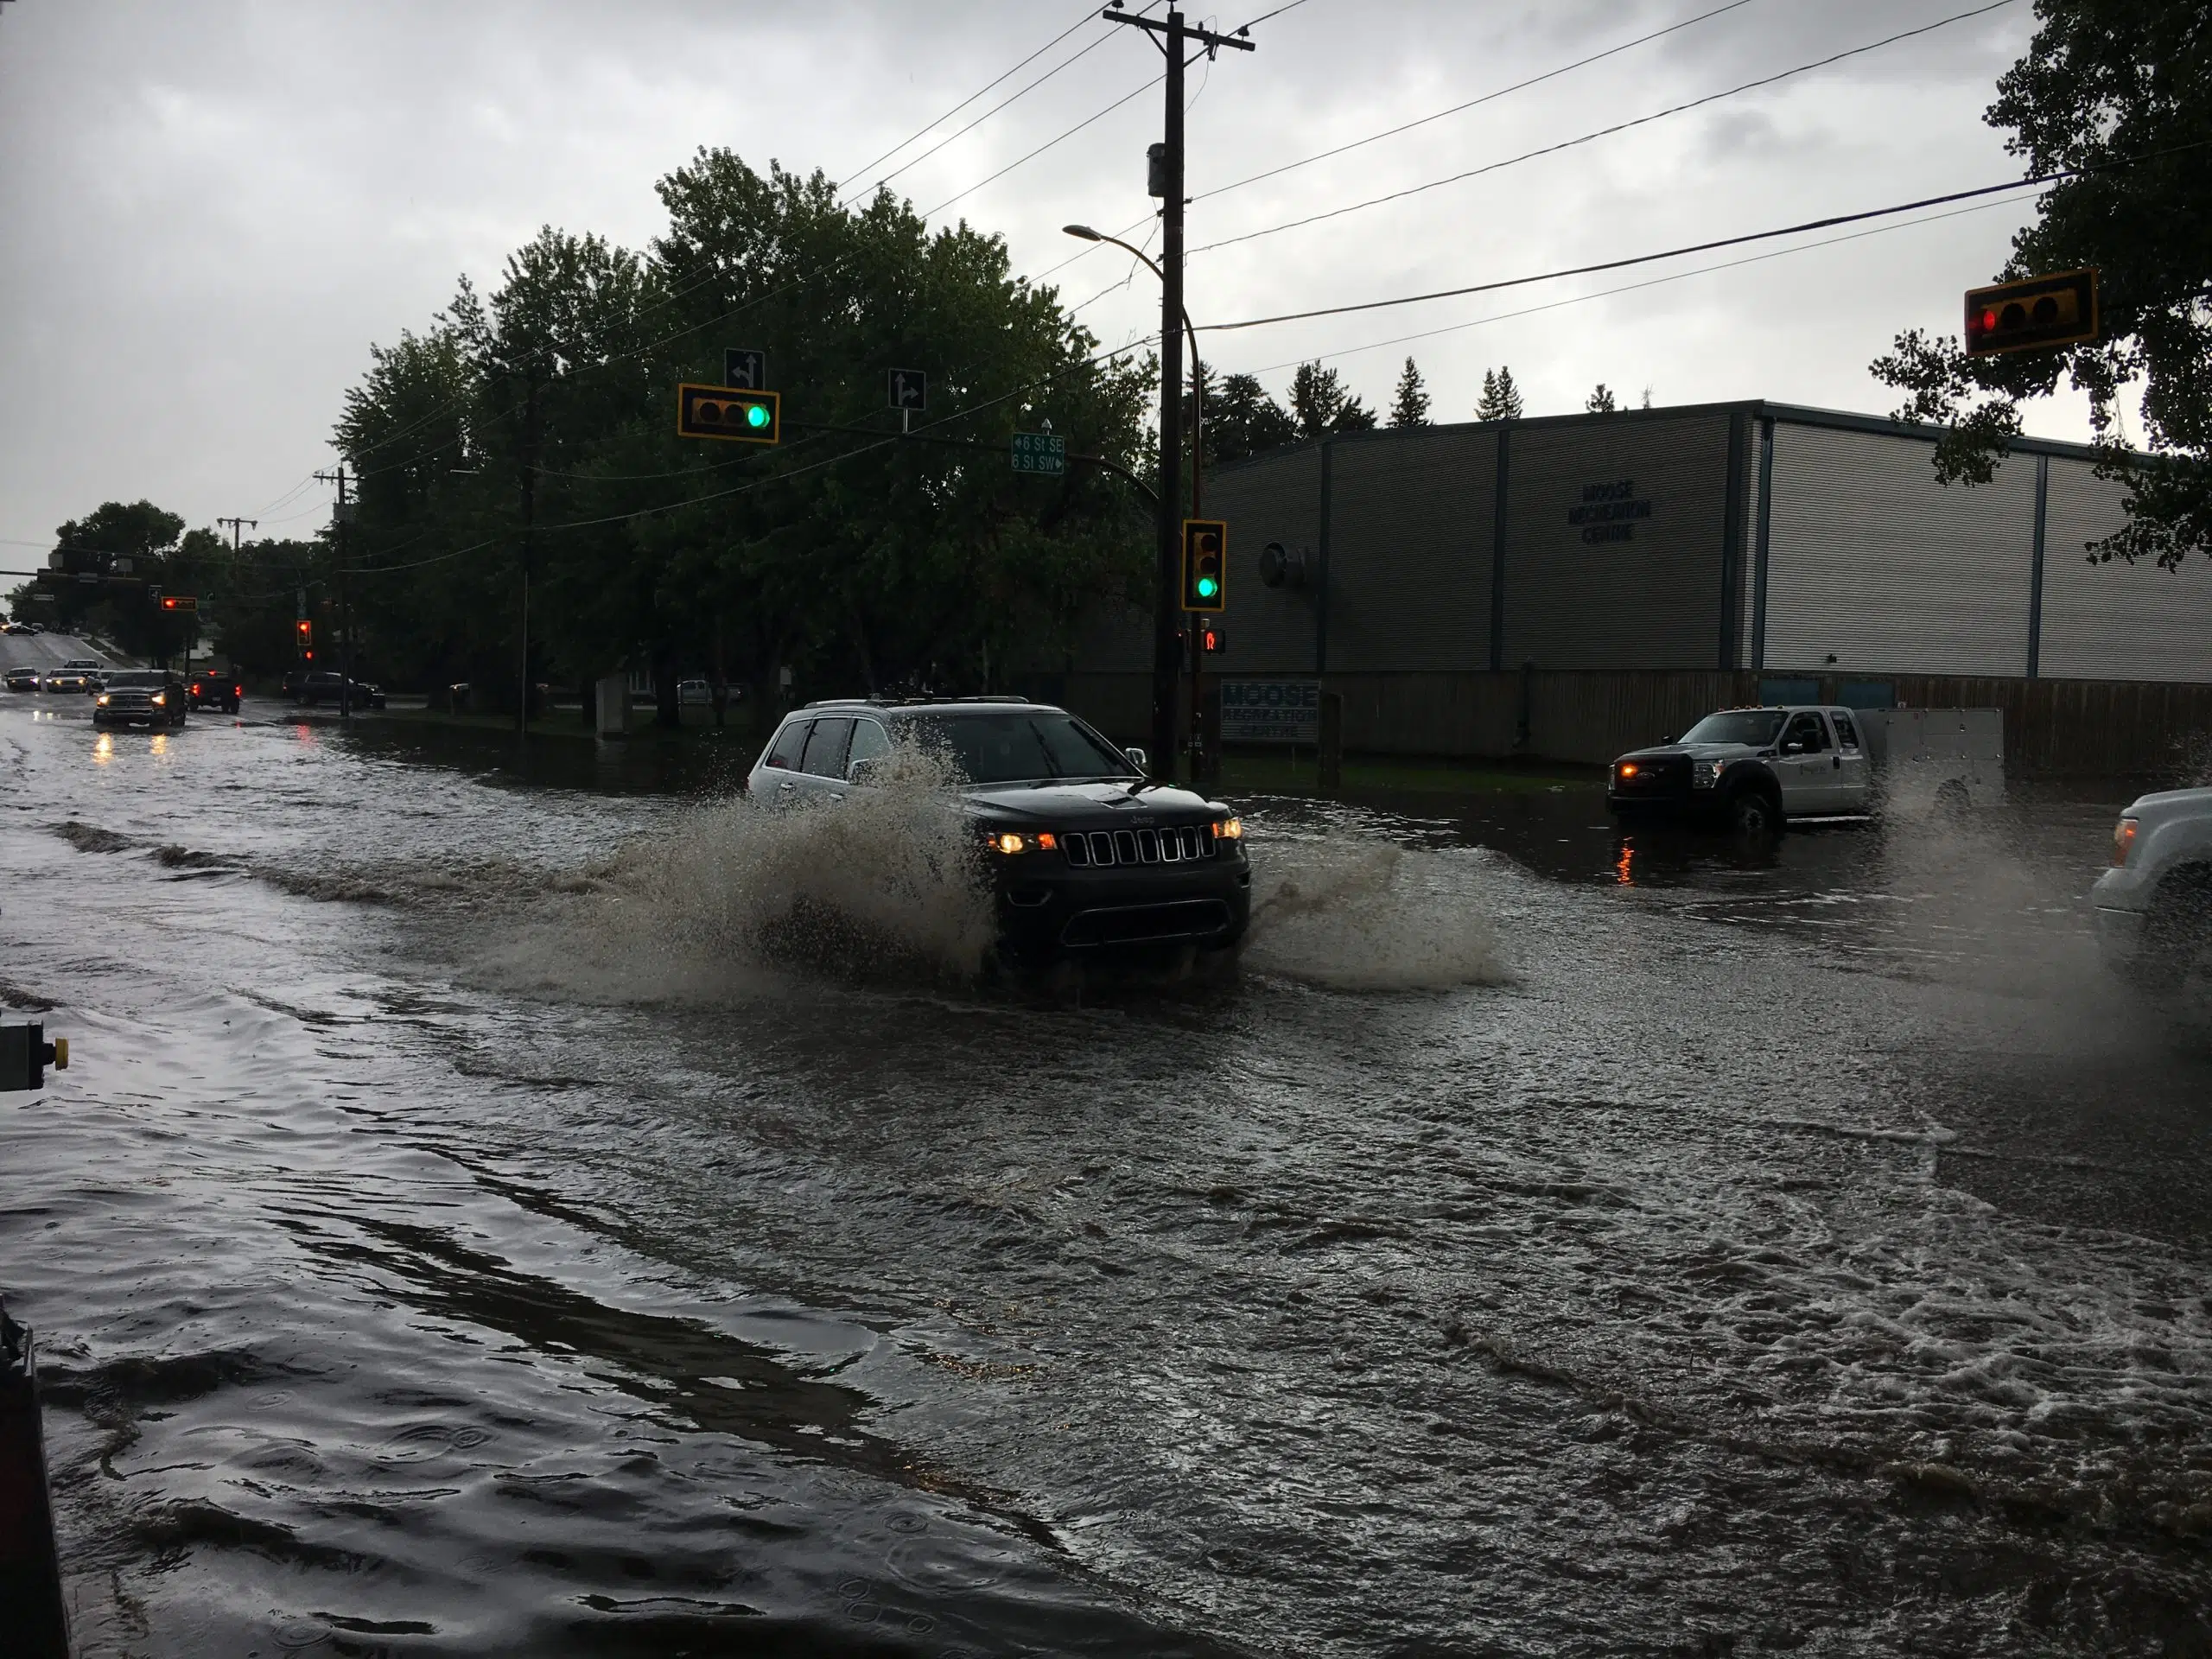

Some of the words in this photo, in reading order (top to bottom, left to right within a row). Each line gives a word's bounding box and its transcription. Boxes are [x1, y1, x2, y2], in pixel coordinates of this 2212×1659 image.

[1023, 435, 1030, 450] 6
[1033, 436, 1045, 452] St
[1050, 438, 1062, 453] SE
[1013, 454, 1019, 468] 6
[1038, 455, 1054, 470] SW
[1583, 480, 1633, 502] MOOSE
[1224, 685, 1318, 706] MOOSE
